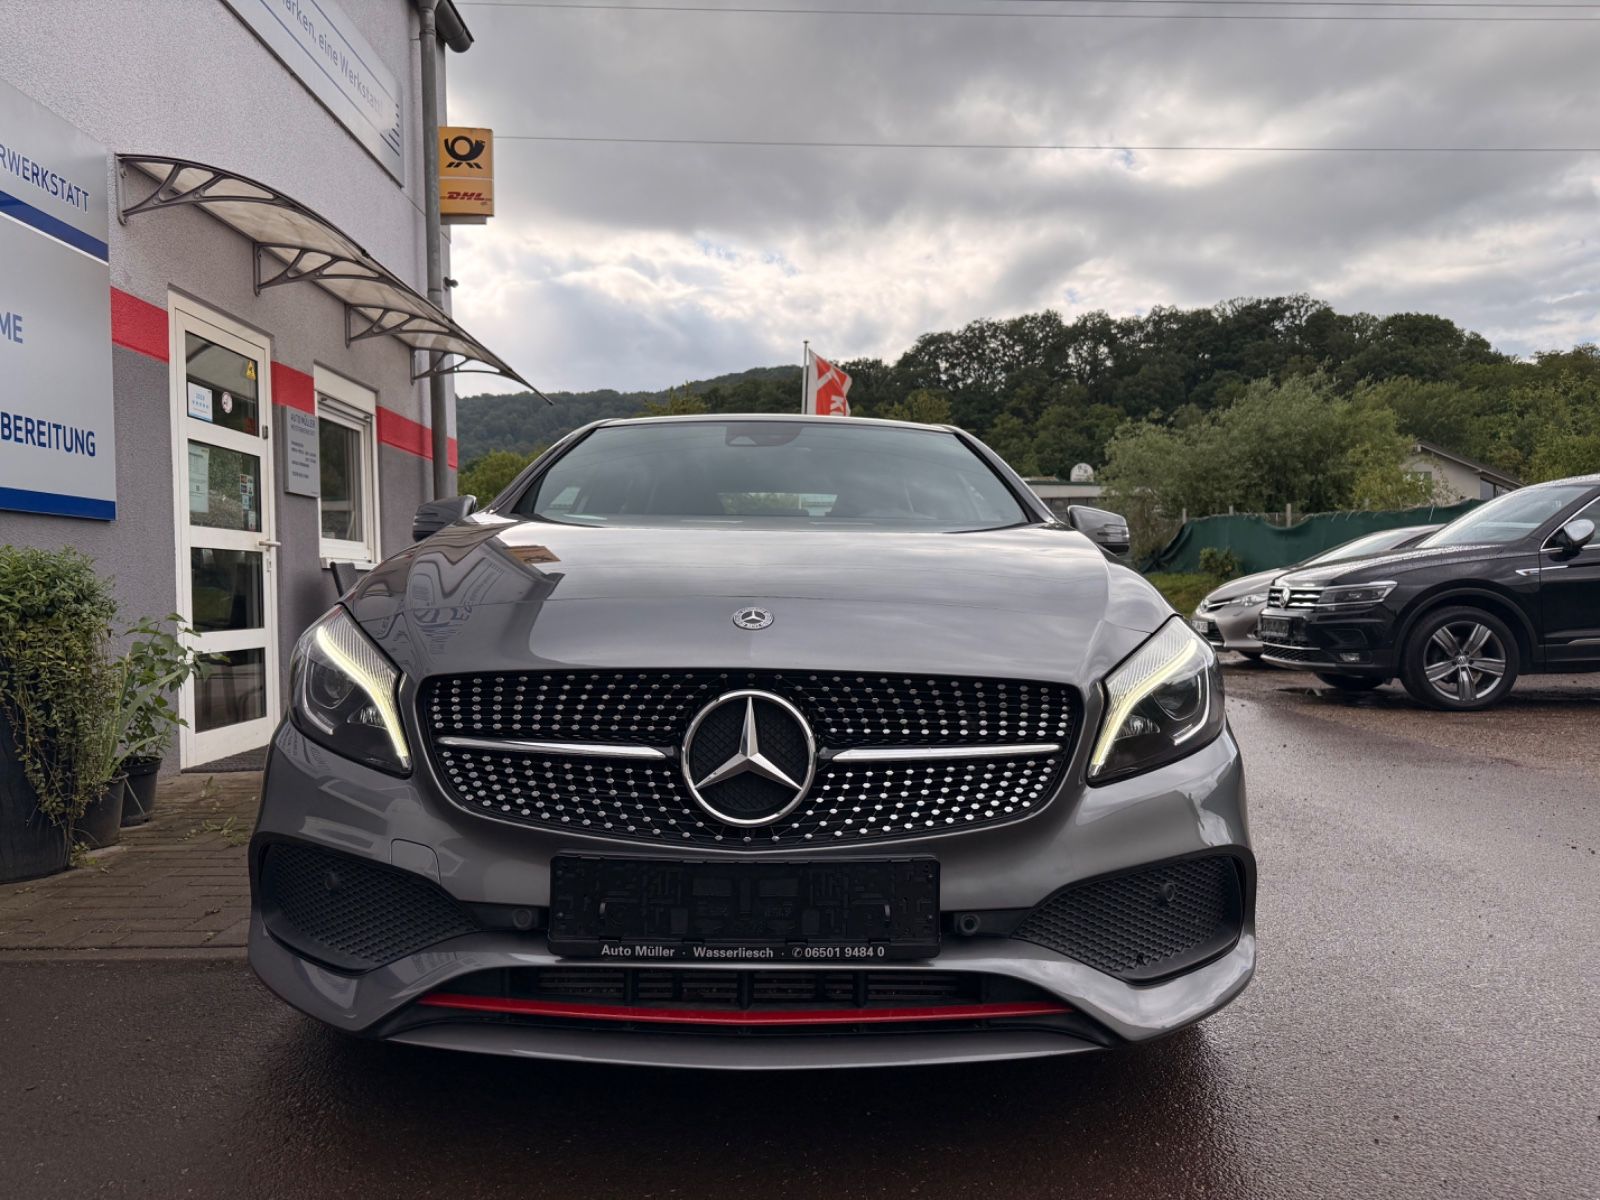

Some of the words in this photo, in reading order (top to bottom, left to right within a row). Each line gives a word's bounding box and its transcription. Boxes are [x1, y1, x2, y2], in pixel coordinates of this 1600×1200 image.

[282, 0, 317, 43] arken,
[318, 34, 338, 65] eine
[0, 144, 89, 212] RWERKSTATT
[446, 191, 485, 201] DHL
[0, 411, 96, 457] BEREITUNG
[601, 944, 631, 956] Auto
[635, 945, 675, 957] Müller
[693, 946, 774, 958] Wasserliesch
[805, 947, 840, 958] 06501
[844, 946, 874, 958] 9484
[877, 946, 885, 957] 0
